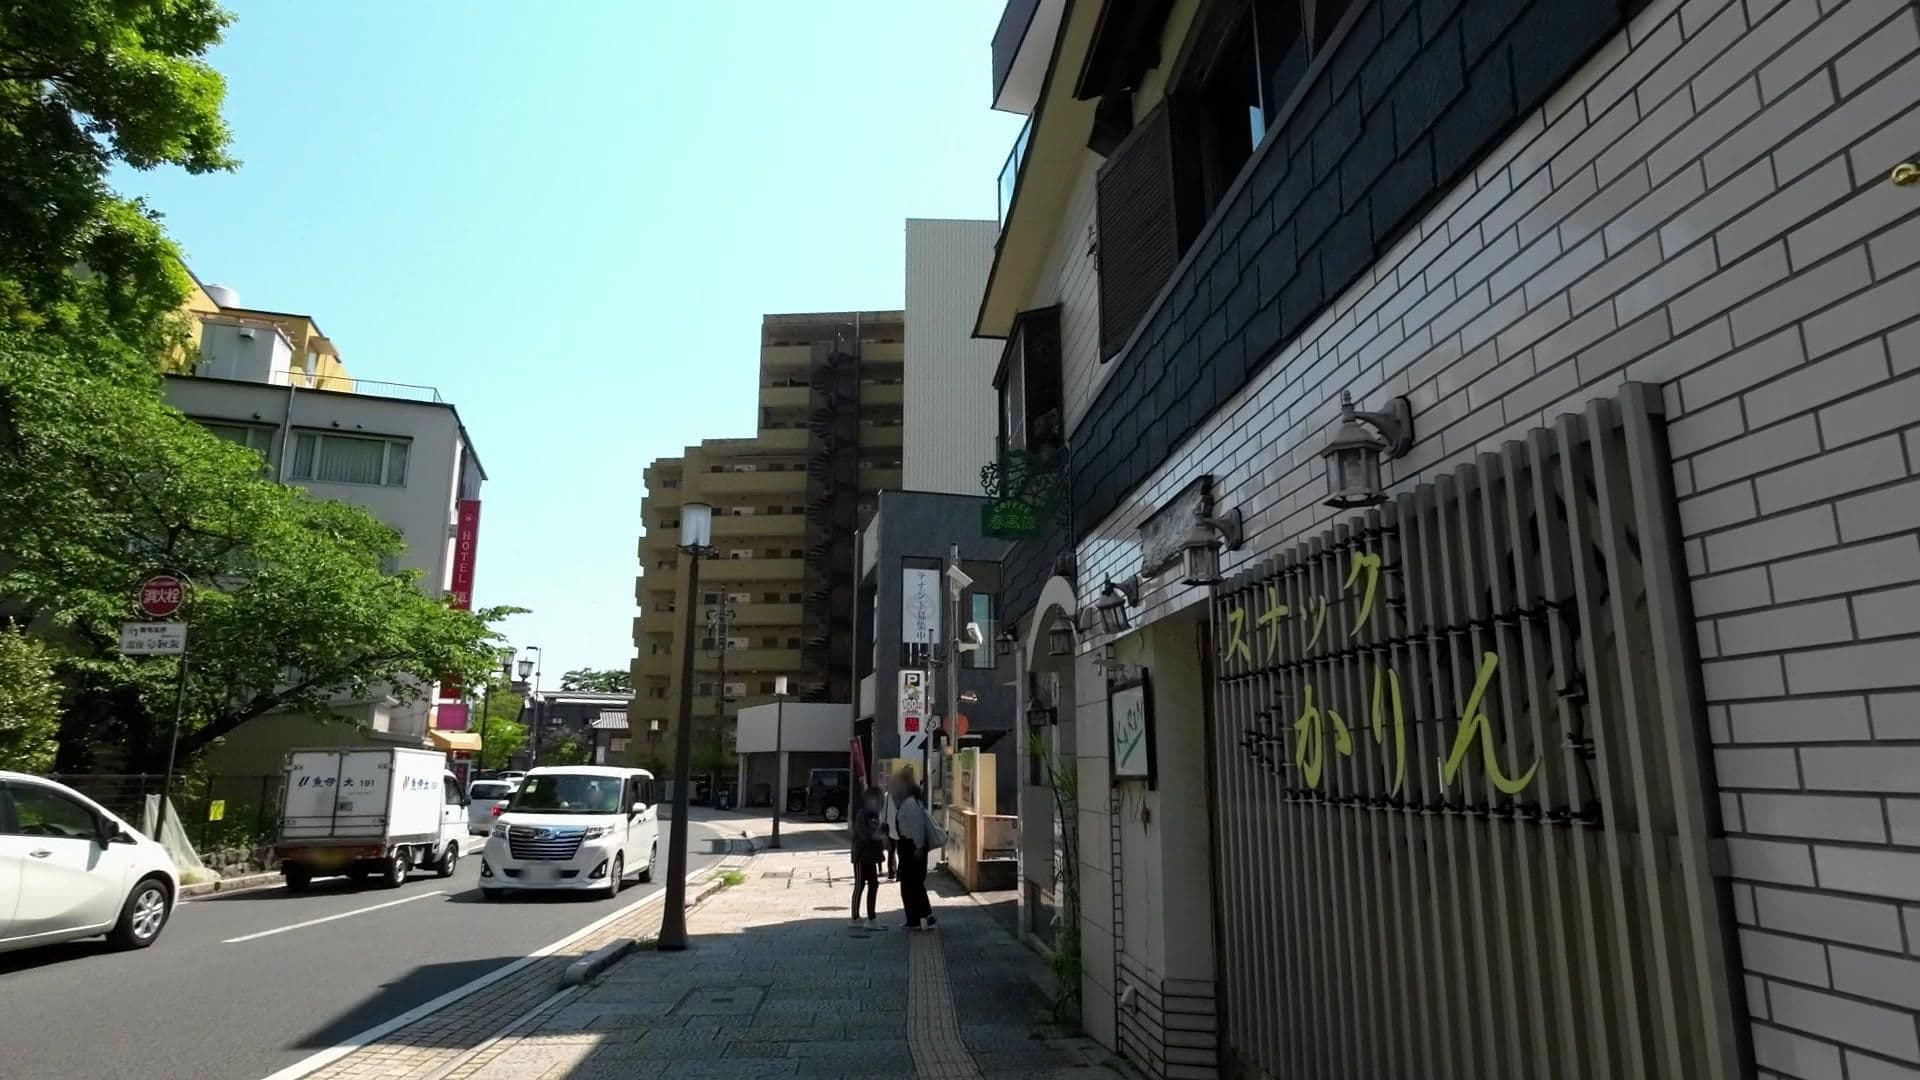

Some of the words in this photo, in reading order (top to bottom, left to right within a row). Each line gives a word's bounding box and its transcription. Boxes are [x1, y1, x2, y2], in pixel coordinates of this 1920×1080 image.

[143, 588, 180, 604] 消火栓
[458, 530, 471, 583] HOTEL
[1224, 551, 1381, 663] スナック
[1294, 652, 1542, 799] かりん
